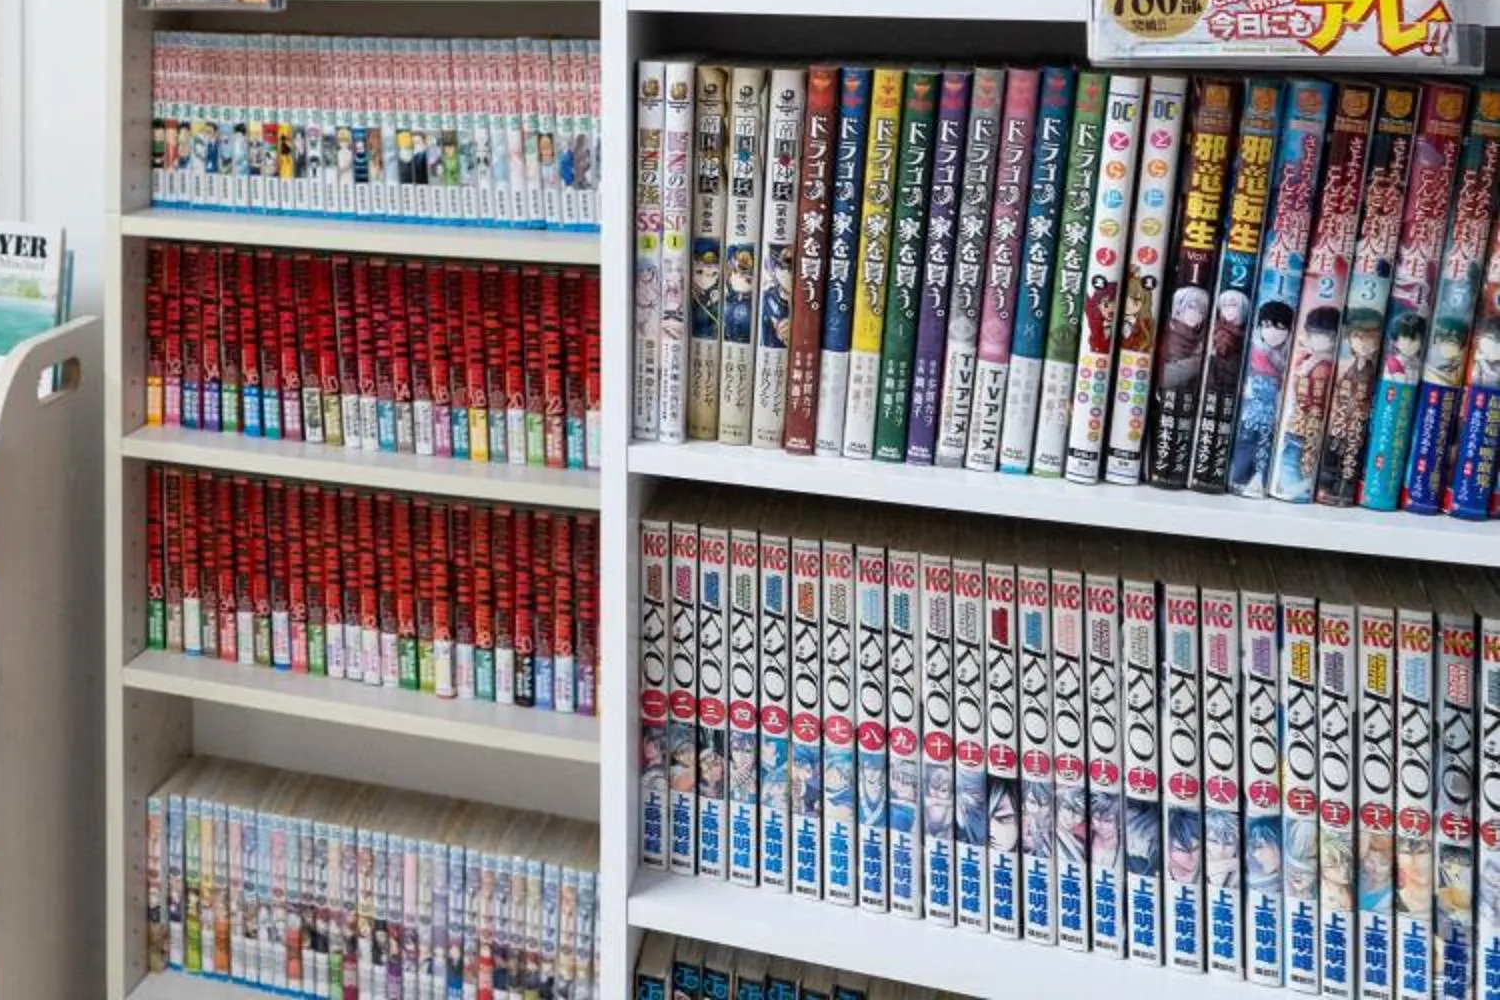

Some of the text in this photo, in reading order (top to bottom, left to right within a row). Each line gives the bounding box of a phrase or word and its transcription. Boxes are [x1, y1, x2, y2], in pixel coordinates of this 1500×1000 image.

[1210, 12, 1313, 39] 今日にも
[1183, 133, 1228, 250] 邪竜転生
[1229, 135, 1272, 252] 邪竜転生
[1230, 265, 1247, 287] 2
[954, 353, 973, 434] TVアニメ
[981, 369, 1003, 450] TVアニメ
[642, 597, 666, 688] KYO
[672, 600, 696, 689] KYO
[700, 605, 726, 695] KYO
[731, 608, 756, 699] KYO
[763, 611, 787, 702] KYO
[795, 618, 819, 710] KYO
[826, 621, 851, 712] KYO
[860, 625, 884, 718] KYO
[890, 629, 914, 724] KYO
[926, 635, 952, 729] KYO
[1206, 673, 1235, 772] KYO
[1362, 692, 1393, 794] KYO
